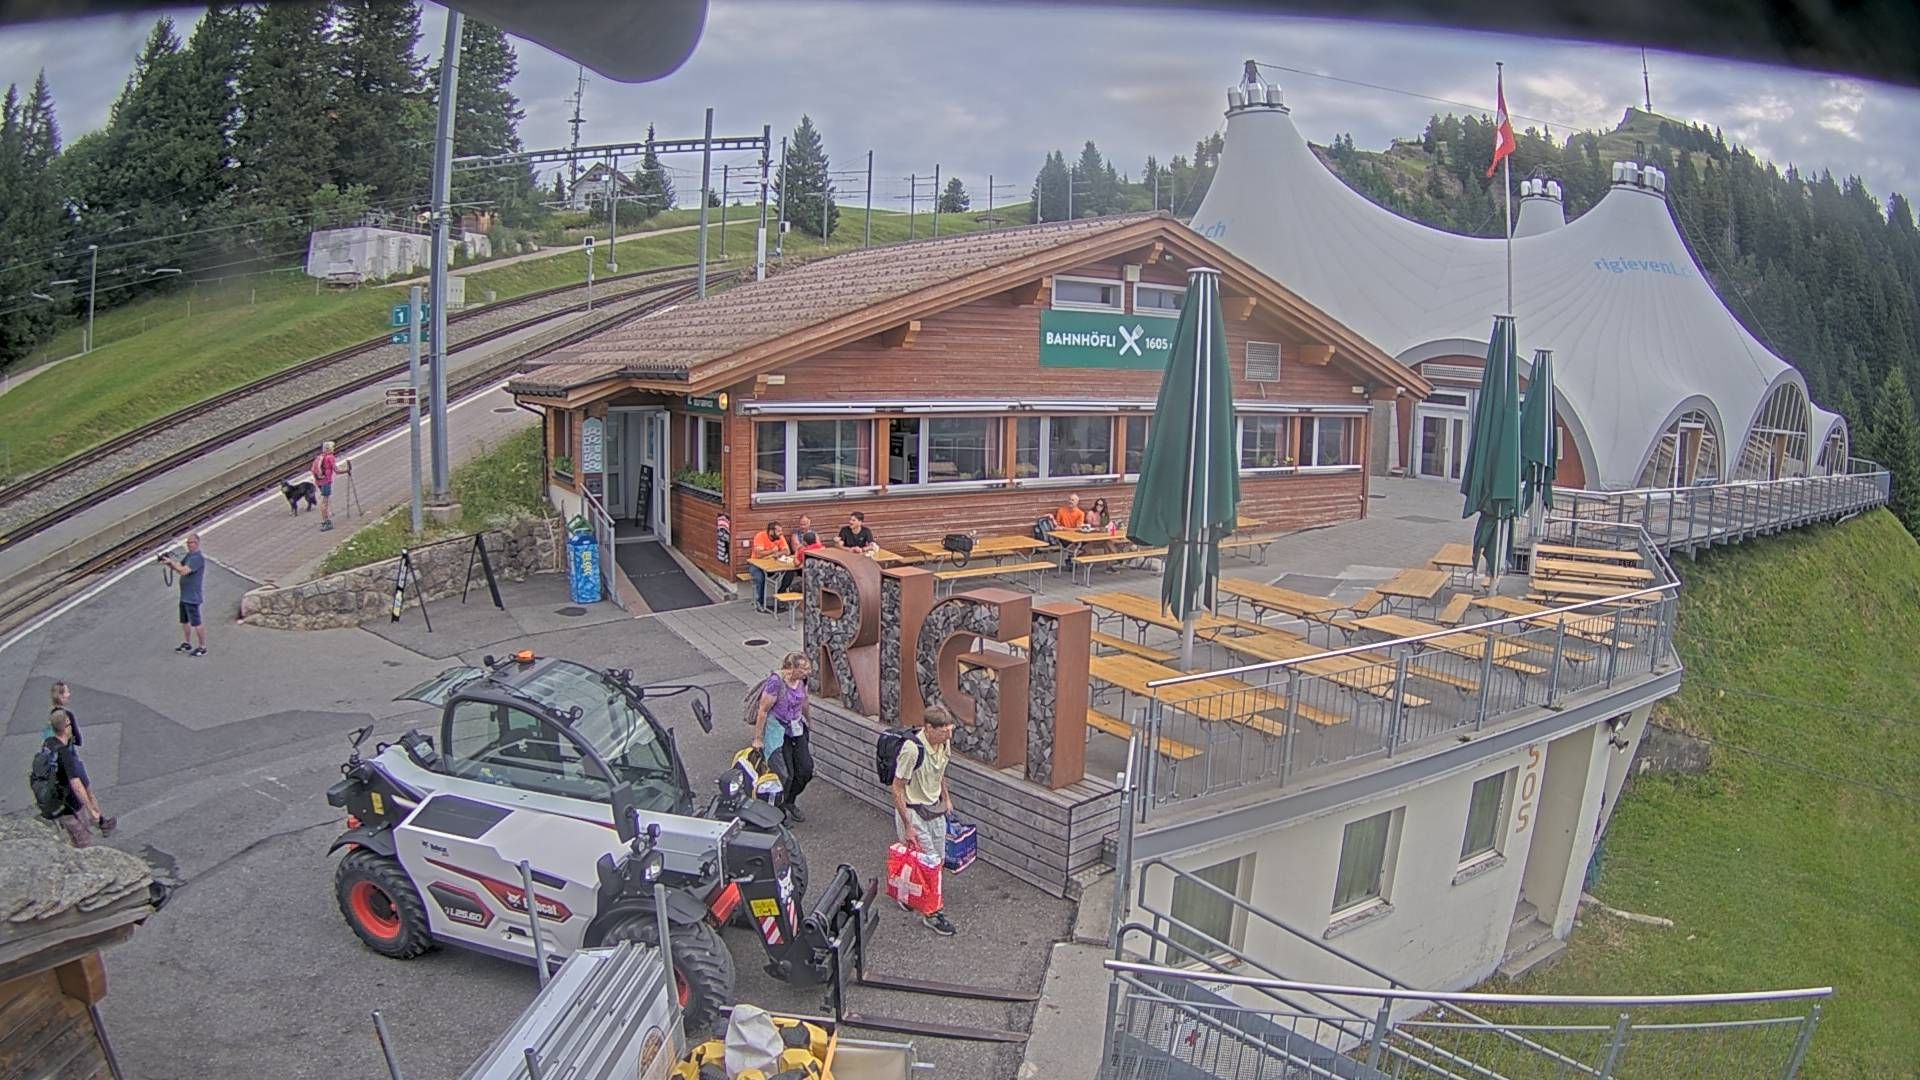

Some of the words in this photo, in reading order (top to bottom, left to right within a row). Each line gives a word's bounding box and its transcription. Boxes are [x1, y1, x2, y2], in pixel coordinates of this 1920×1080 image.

[1046, 331, 1116, 348] BAHNHÖFLI
[1145, 337, 1168, 350] 1605
[802, 548, 1092, 790] RIGI
[1516, 743, 1540, 833] SOS
